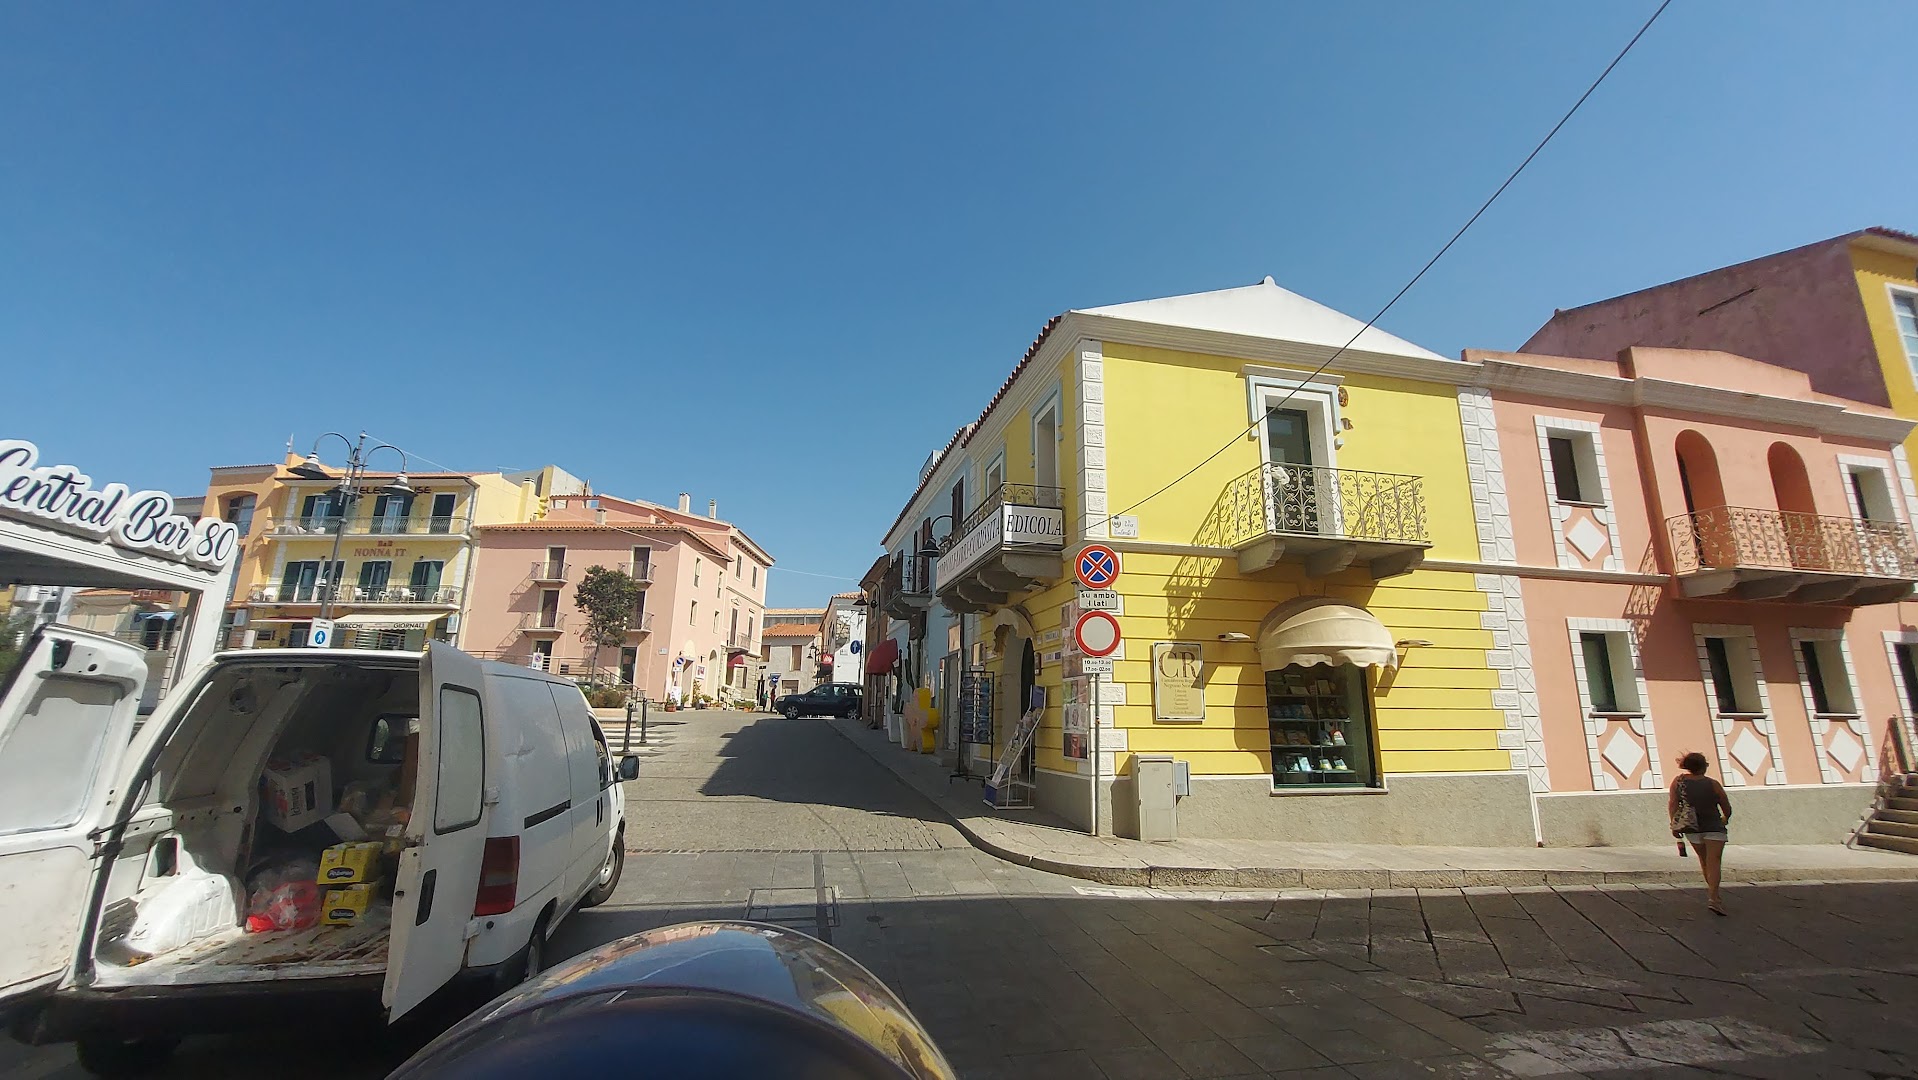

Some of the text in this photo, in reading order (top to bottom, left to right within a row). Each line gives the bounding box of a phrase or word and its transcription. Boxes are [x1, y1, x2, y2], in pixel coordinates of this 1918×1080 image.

[0, 447, 235, 561] Central Bar 80
[1006, 513, 1062, 536] EDICOLA
[354, 548, 391, 557] NONNA
[1158, 650, 1200, 679] CR
